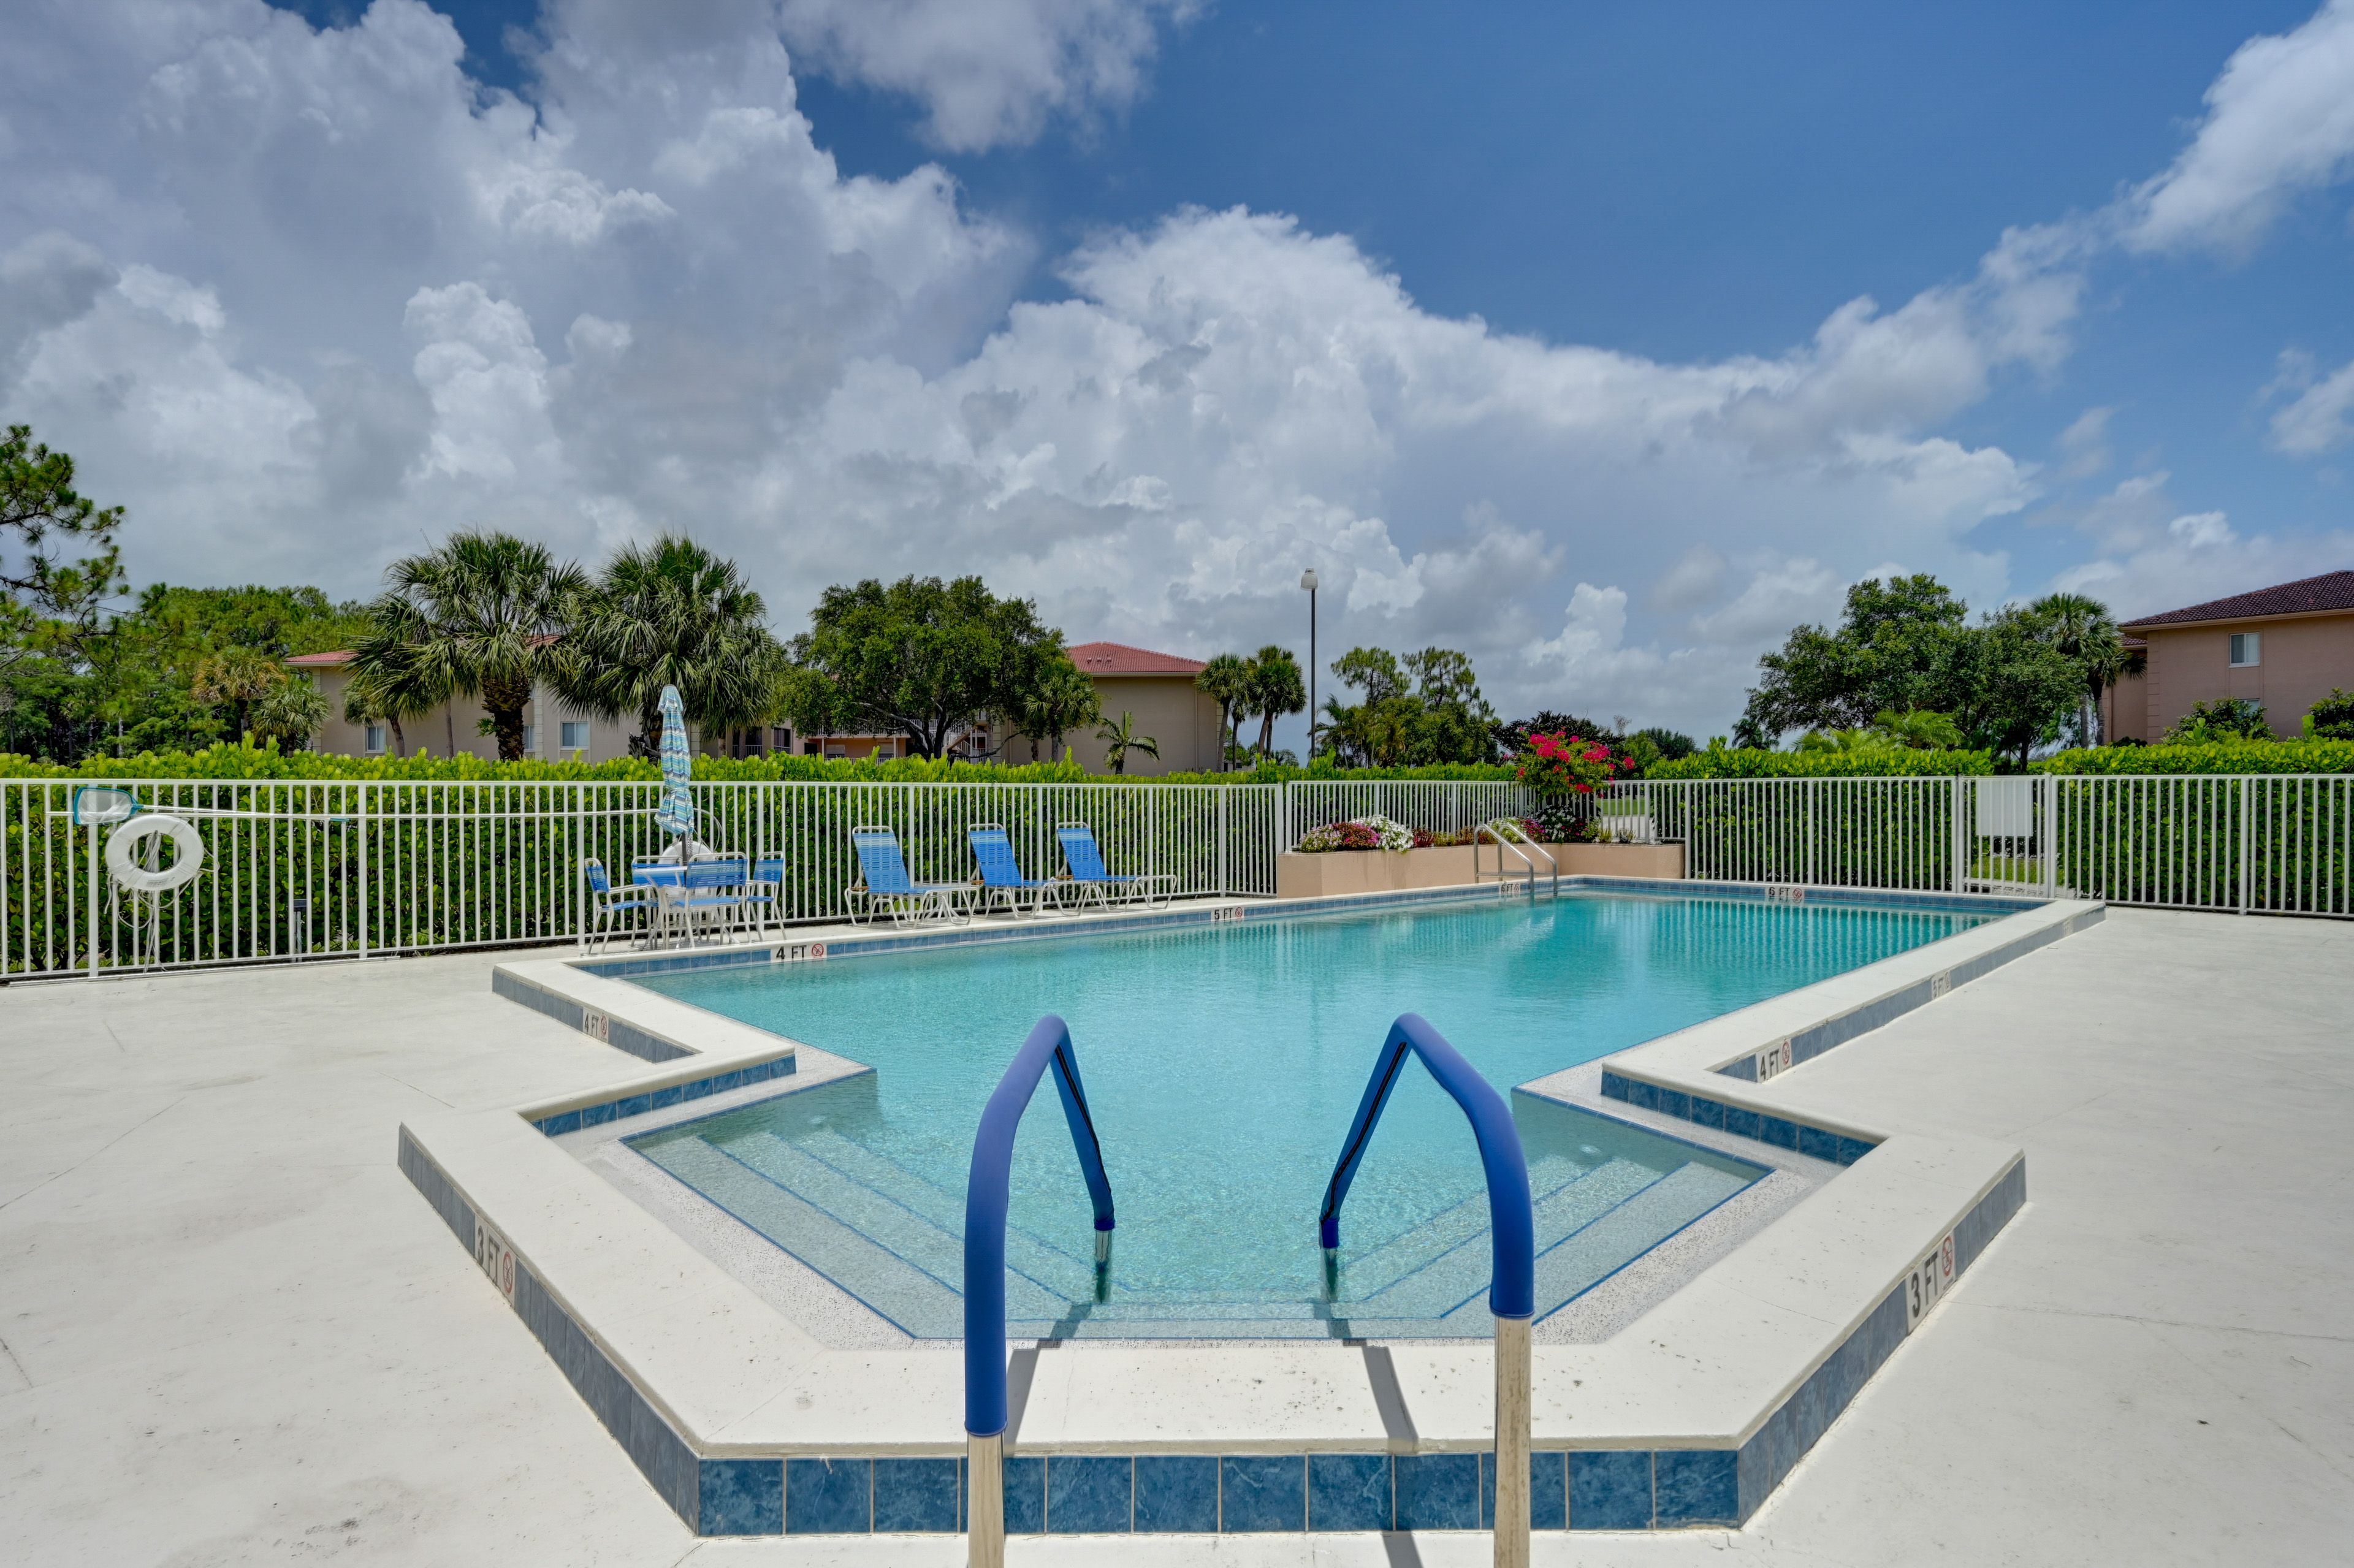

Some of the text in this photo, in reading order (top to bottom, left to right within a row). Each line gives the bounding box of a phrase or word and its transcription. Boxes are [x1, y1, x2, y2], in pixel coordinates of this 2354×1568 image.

[1769, 887, 1790, 898] 6 FT
[1214, 907, 1233, 920] 5 FT
[775, 945, 807, 960] 4 FT
[584, 1013, 599, 1037] 4 FT
[1760, 1048, 1780, 1081] 4 FT
[478, 1225, 500, 1285] 3 FT
[1911, 1250, 1938, 1318] 3 FT
